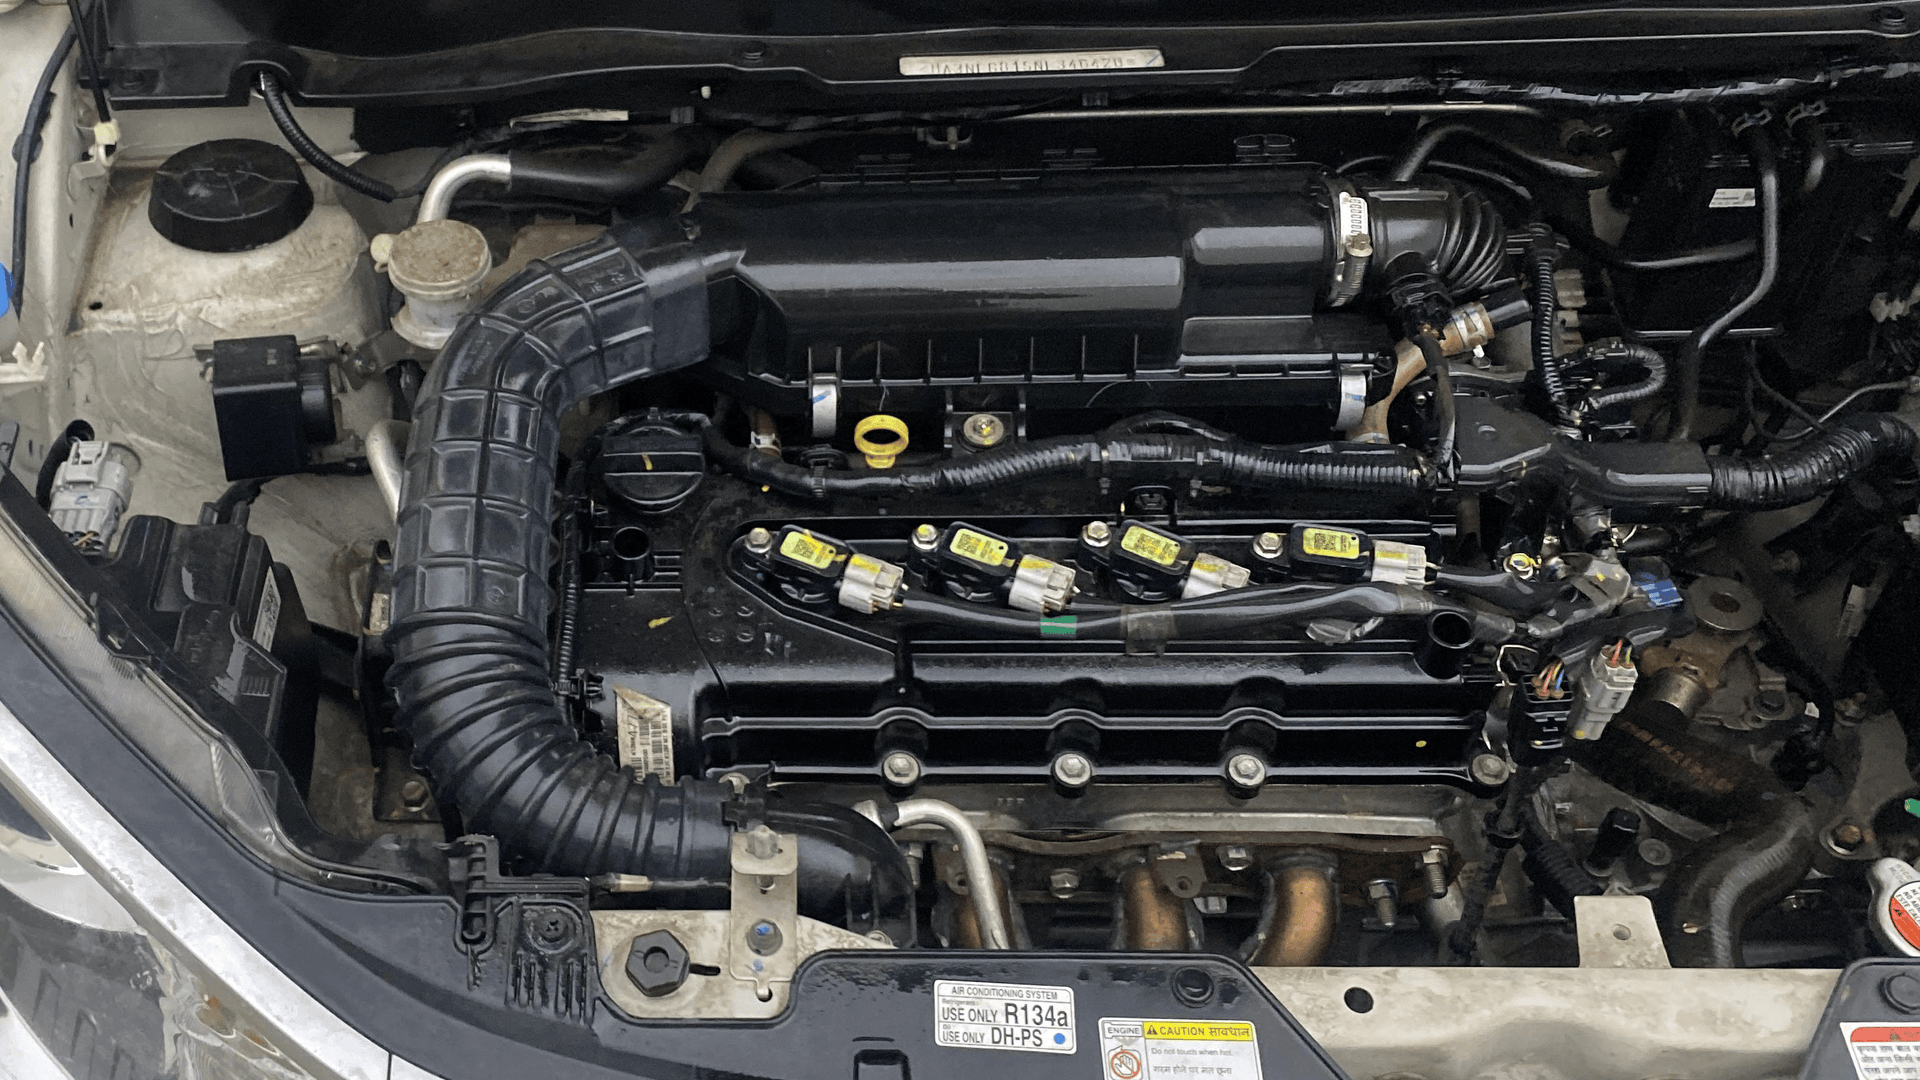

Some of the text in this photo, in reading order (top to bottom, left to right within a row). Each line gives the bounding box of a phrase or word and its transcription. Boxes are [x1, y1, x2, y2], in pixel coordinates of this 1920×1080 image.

[952, 986, 1058, 1000] AIR CONDITIONING SYSTEM
[942, 1002, 1068, 1027] USE ONLY R134a
[1107, 1027, 1140, 1035] ENGINE
[1159, 1026, 1205, 1036] CAUTION
[1208, 1027, 1250, 1037] सावधान
[942, 1027, 1043, 1047] USE ONLY DH-PS
[1151, 1047, 1162, 1055] Do
[1188, 1066, 1199, 1074] पर
